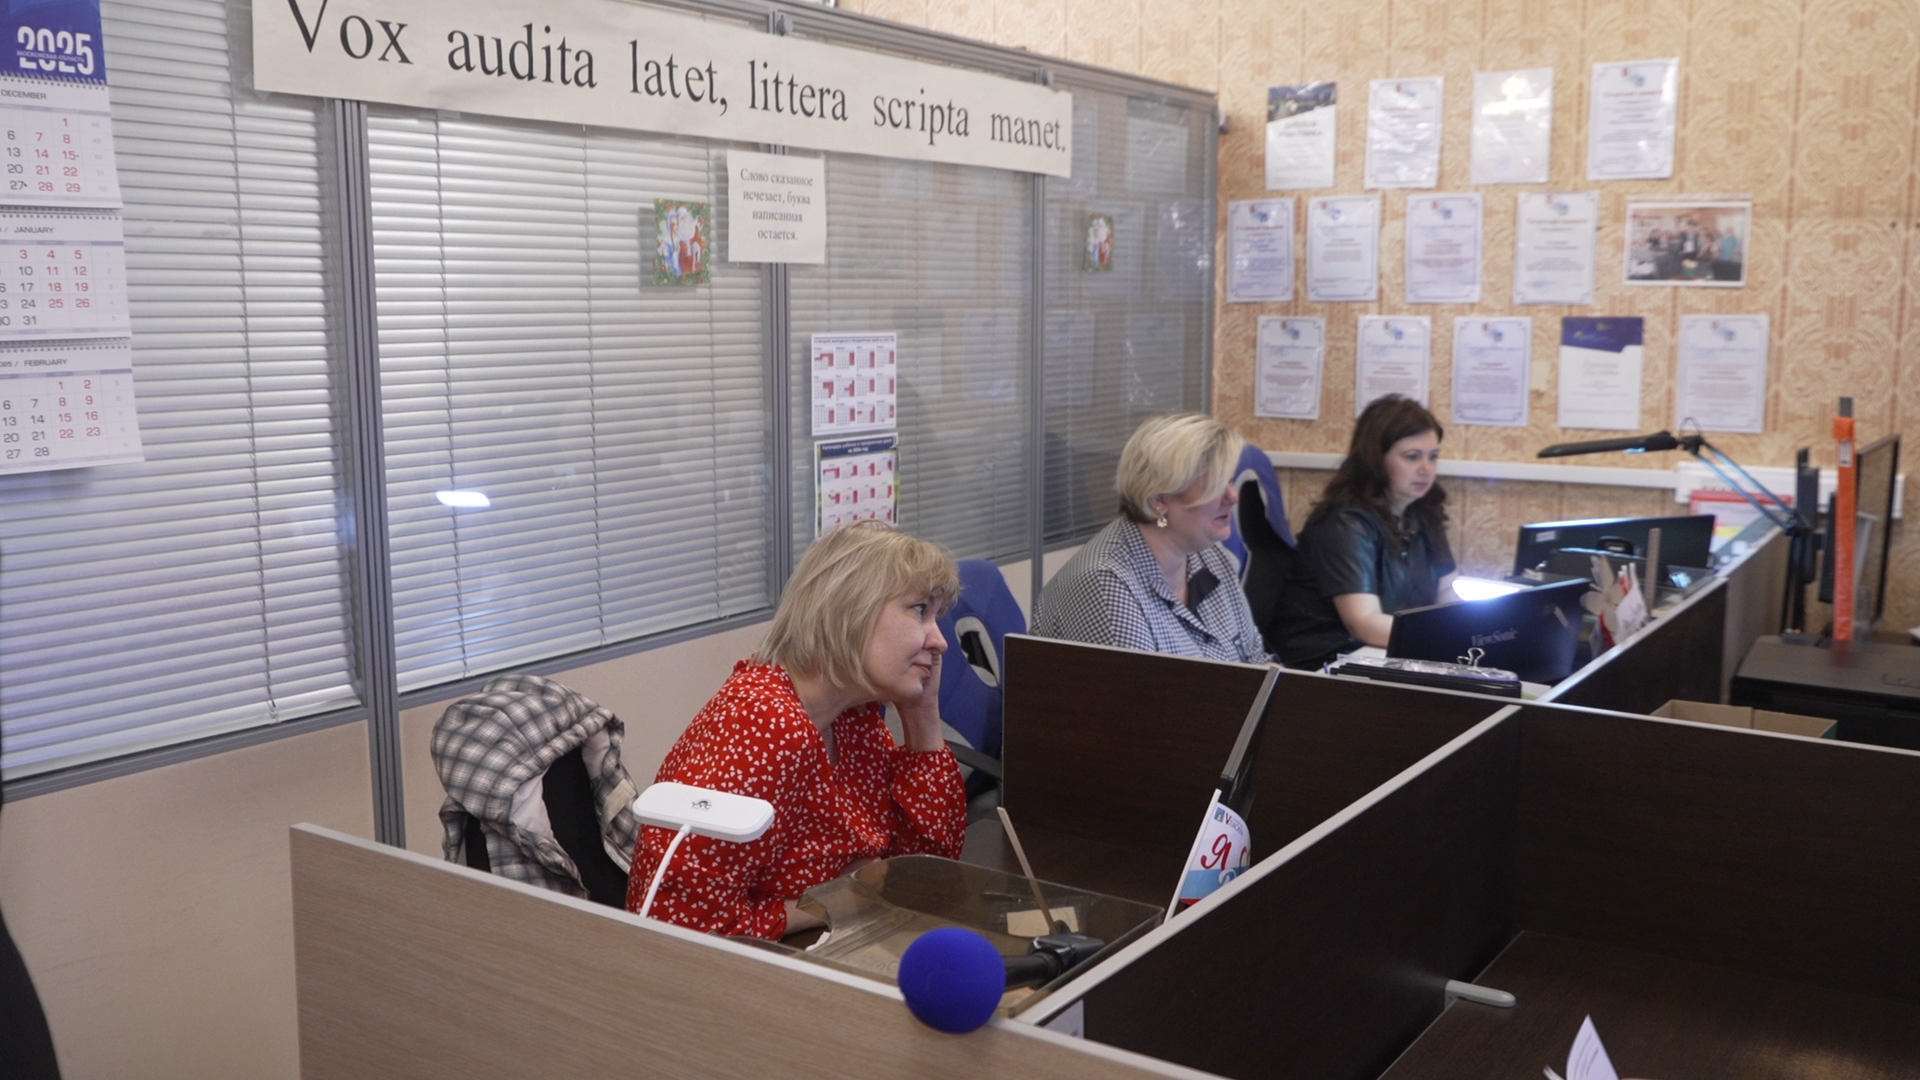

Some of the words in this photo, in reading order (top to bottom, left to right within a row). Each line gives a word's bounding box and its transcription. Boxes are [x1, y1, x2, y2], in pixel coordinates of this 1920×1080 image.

[17, 25, 94, 75] 2025
[288, 0, 413, 65] Vox
[447, 23, 598, 89] audita
[629, 39, 728, 116] latet,
[748, 60, 848, 122] littera
[873, 88, 970, 146] scripta
[990, 111, 1066, 152] manet.
[0, 89, 47, 100] DECEMBER
[62, 118, 68, 127] 1
[7, 130, 16, 140] 6
[35, 132, 43, 141] 7
[62, 134, 71, 145] 8
[6, 147, 21, 157] 13
[34, 149, 49, 158] 14
[62, 151, 76, 161] 15
[7, 164, 24, 174] 20
[35, 165, 50, 176] 21
[63, 167, 78, 178] 22
[740, 167, 769, 183] Слово
[770, 173, 814, 187] сказанное
[9, 180, 24, 190] 27
[38, 181, 54, 193] 28
[65, 183, 81, 194] 29
[743, 190, 785, 203] исчезает,
[787, 191, 810, 206] буква
[752, 210, 803, 222] написанная
[13, 226, 54, 234] JANUARY
[757, 229, 798, 241] остается.
[19, 249, 28, 260] 3
[46, 249, 56, 259] 4
[74, 249, 83, 260] 5
[18, 265, 34, 277] 10
[46, 265, 60, 276] 11
[73, 265, 88, 276] 12
[0, 282, 7, 293] 6
[20, 282, 35, 293] 17
[47, 282, 62, 293] 18
[74, 282, 89, 293] 19
[0, 299, 8, 309] 3
[20, 299, 36, 309] 24
[48, 299, 64, 309] 25
[75, 298, 90, 309] 26
[23, 315, 37, 326] 31
[24, 358, 68, 367] FEBRUARY
[57, 381, 64, 390] 1
[83, 379, 92, 390] 2
[2, 400, 11, 410] 6
[30, 398, 39, 408] 7
[58, 396, 67, 407] 8
[85, 395, 94, 405] 9
[2, 416, 17, 426] 13
[30, 415, 45, 424] 14
[57, 413, 72, 423] 15
[84, 411, 99, 421] 16
[3, 432, 20, 443] 20
[31, 430, 45, 441] 21
[59, 428, 75, 439] 22
[86, 426, 101, 437] 23
[6, 448, 21, 459] 27
[34, 446, 50, 457] 28
[1471, 628, 1518, 646] ViewSonic
